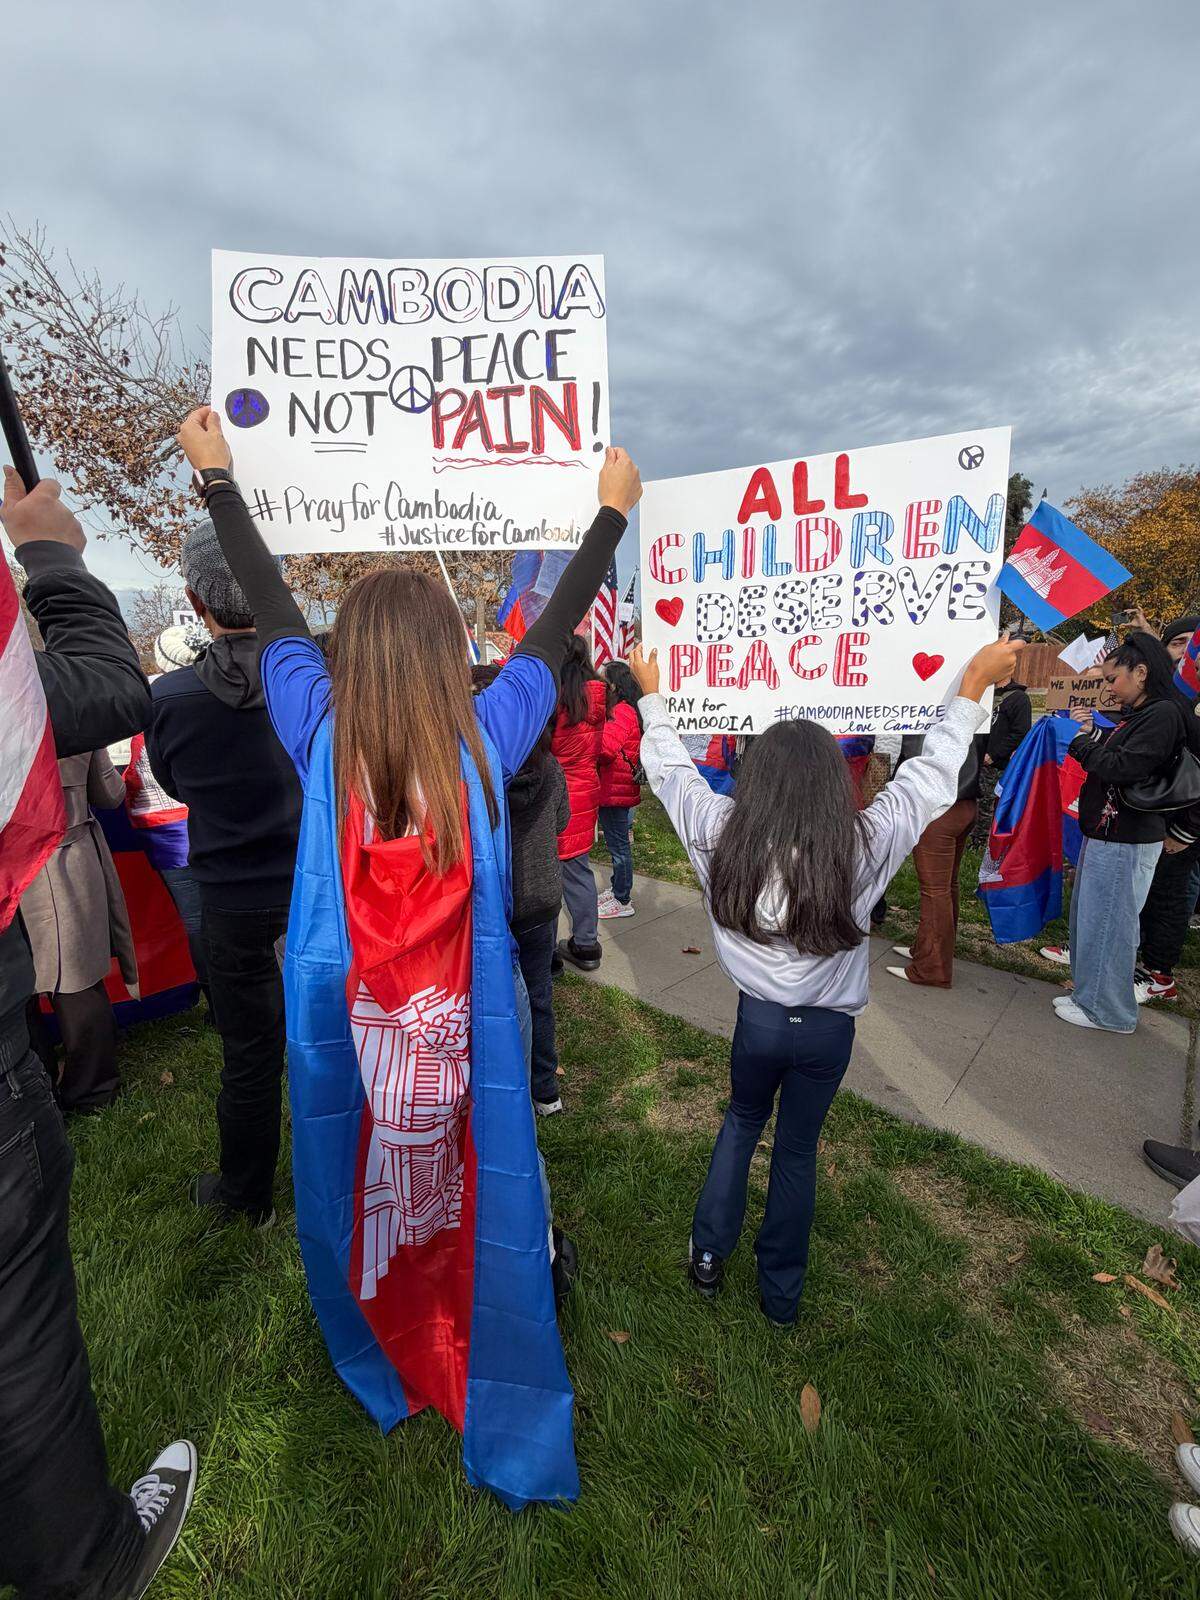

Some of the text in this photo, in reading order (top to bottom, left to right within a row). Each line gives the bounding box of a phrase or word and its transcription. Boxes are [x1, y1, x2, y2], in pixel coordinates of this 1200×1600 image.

[229, 264, 605, 325] CAMBODIA
[246, 328, 577, 385] NEEDS PEACE
[288, 381, 604, 455] NOT PAIN!
[737, 453, 869, 524] ALL
[649, 493, 1005, 584] CHILDREN
[696, 560, 990, 643] DESERVE
[668, 632, 870, 692] PEACE
[1050, 679, 1104, 691] WE WANT
[665, 696, 727, 713] RAY for
[670, 715, 754, 731] AMBODIA
[774, 704, 946, 722] #CAMBODIANEEDSPEACE
[884, 719, 944, 732] Cambo
[1068, 695, 1097, 708] PEACE
